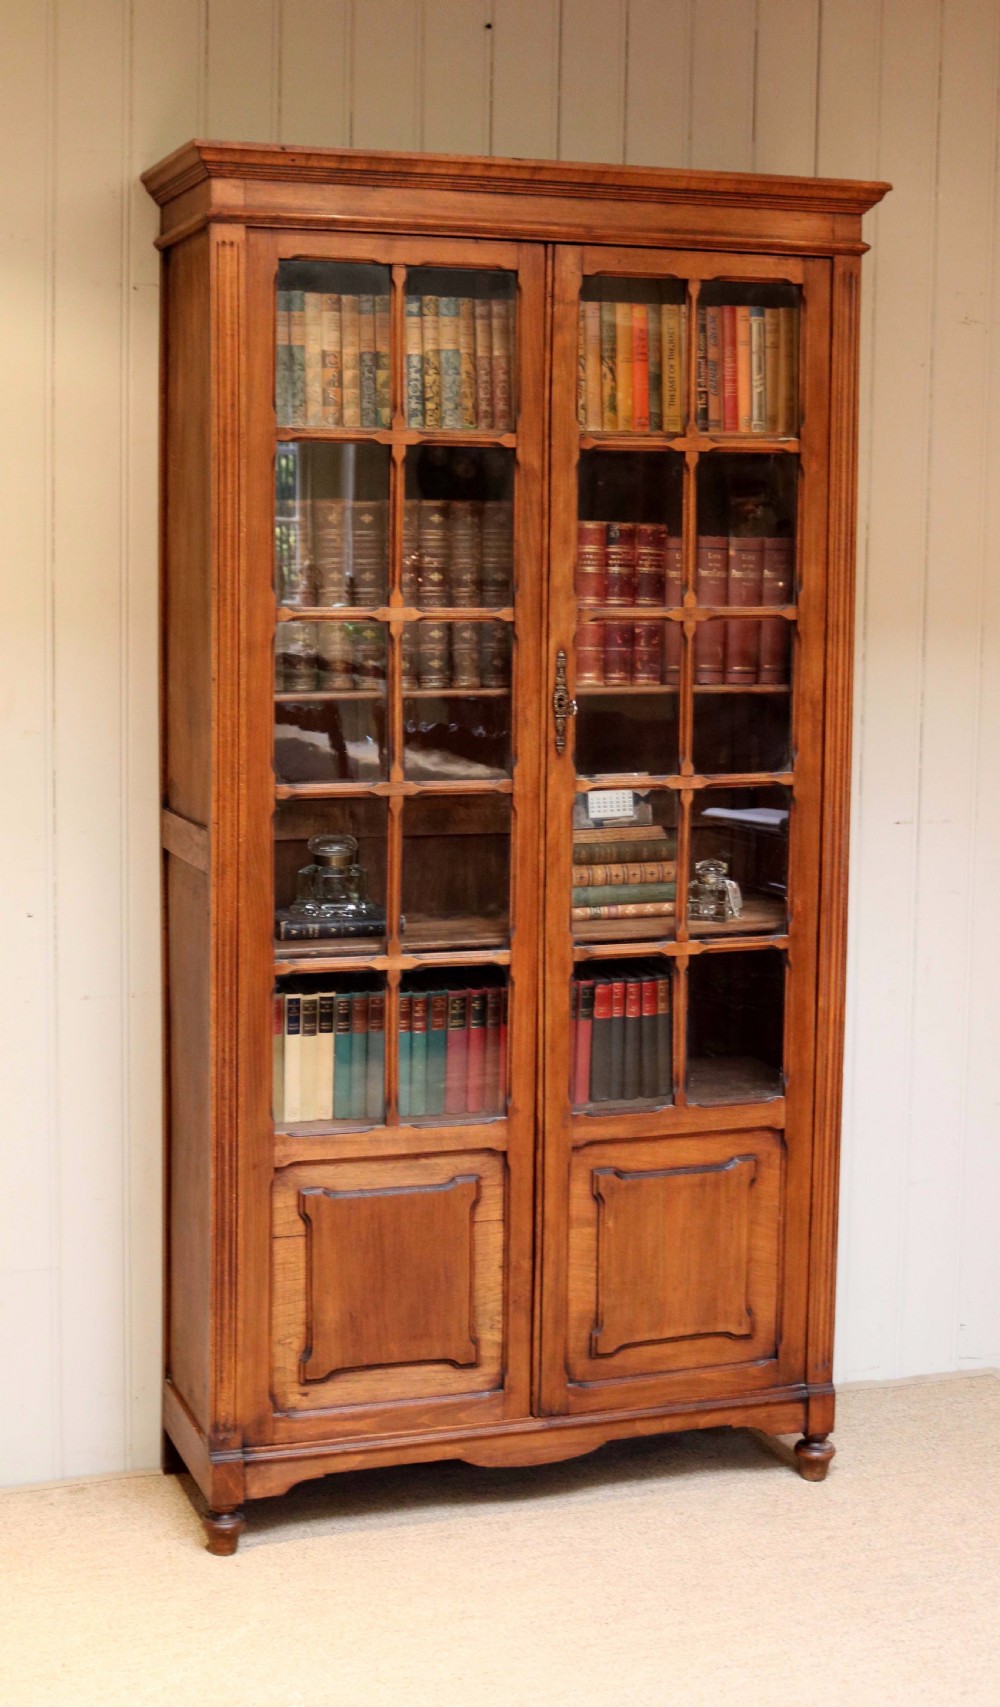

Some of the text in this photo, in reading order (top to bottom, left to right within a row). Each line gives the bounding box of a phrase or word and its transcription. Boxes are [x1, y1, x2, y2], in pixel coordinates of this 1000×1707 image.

[667, 347, 675, 360] THE
[667, 376, 676, 392] LAST
[667, 394, 676, 407] THE
